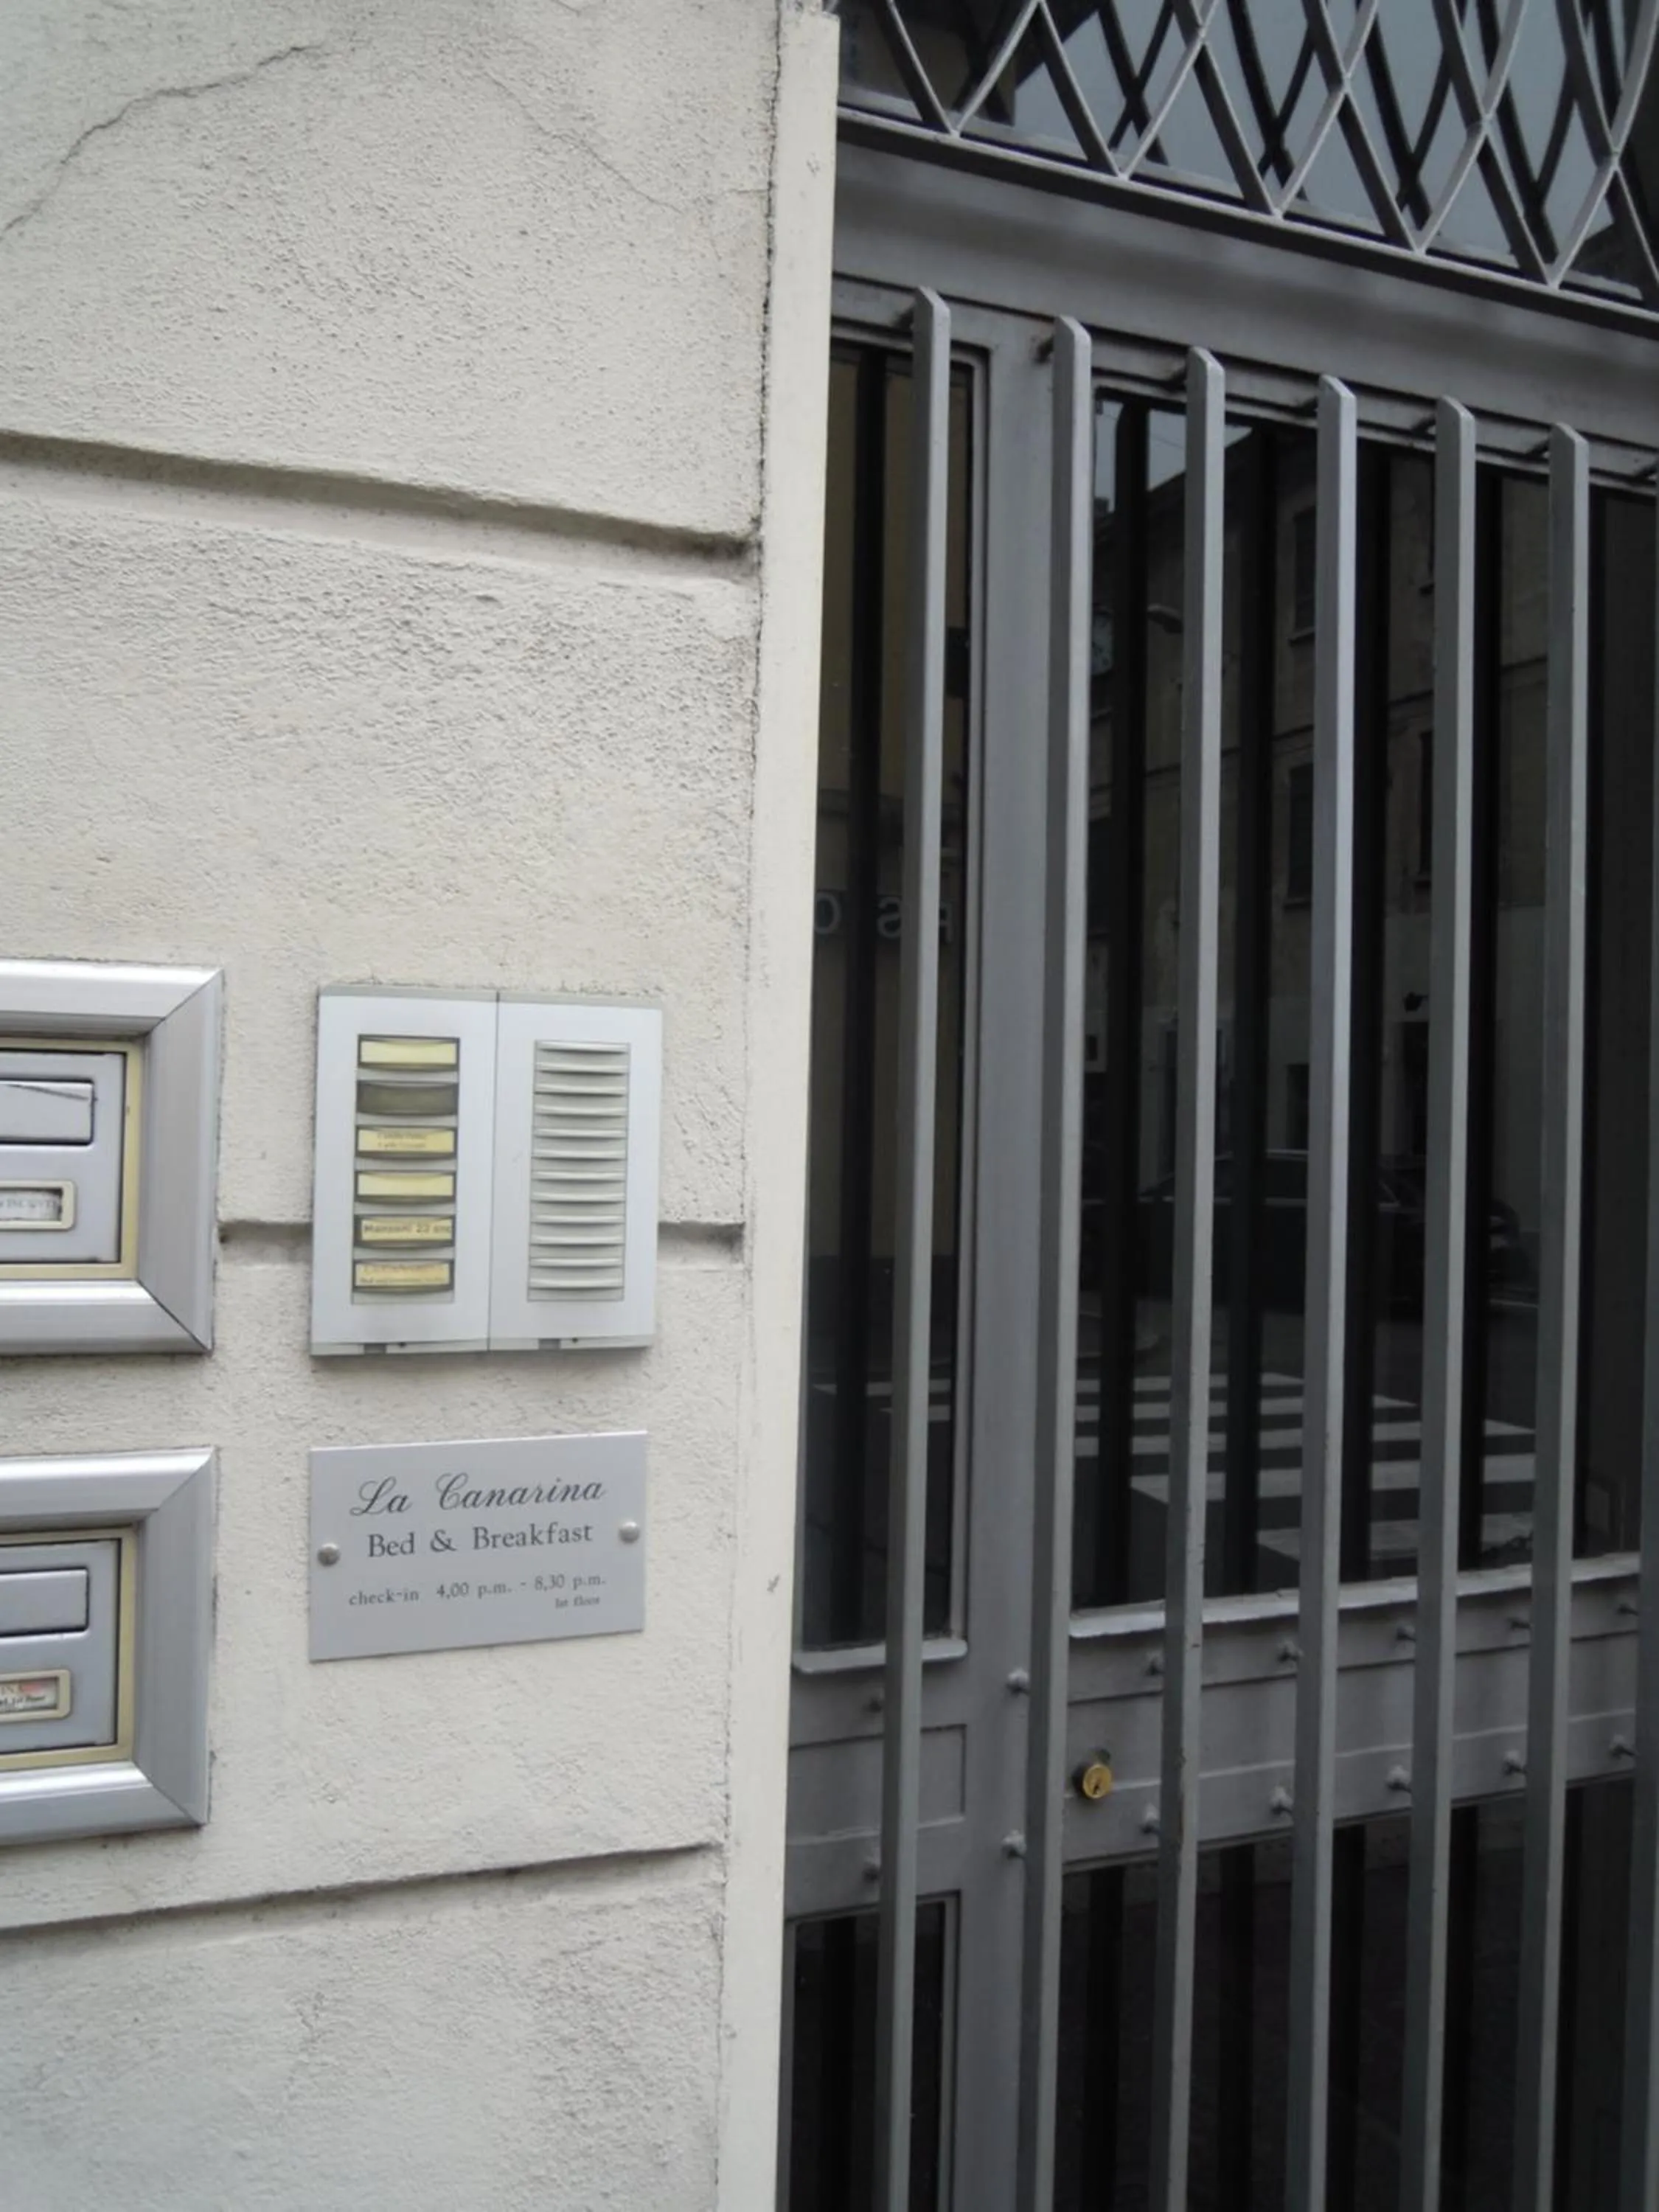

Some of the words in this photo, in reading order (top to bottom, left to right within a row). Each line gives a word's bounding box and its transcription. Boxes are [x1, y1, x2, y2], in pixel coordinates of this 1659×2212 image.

[349, 1475, 412, 1516] La
[436, 1472, 606, 1510] Canarina
[368, 1531, 415, 1557] Bed
[430, 1528, 457, 1552] &
[473, 1521, 593, 1550] Breakfast
[349, 1587, 420, 1605] check-in
[478, 1583, 512, 1599] p.m.
[573, 1575, 605, 1590] p.m.
